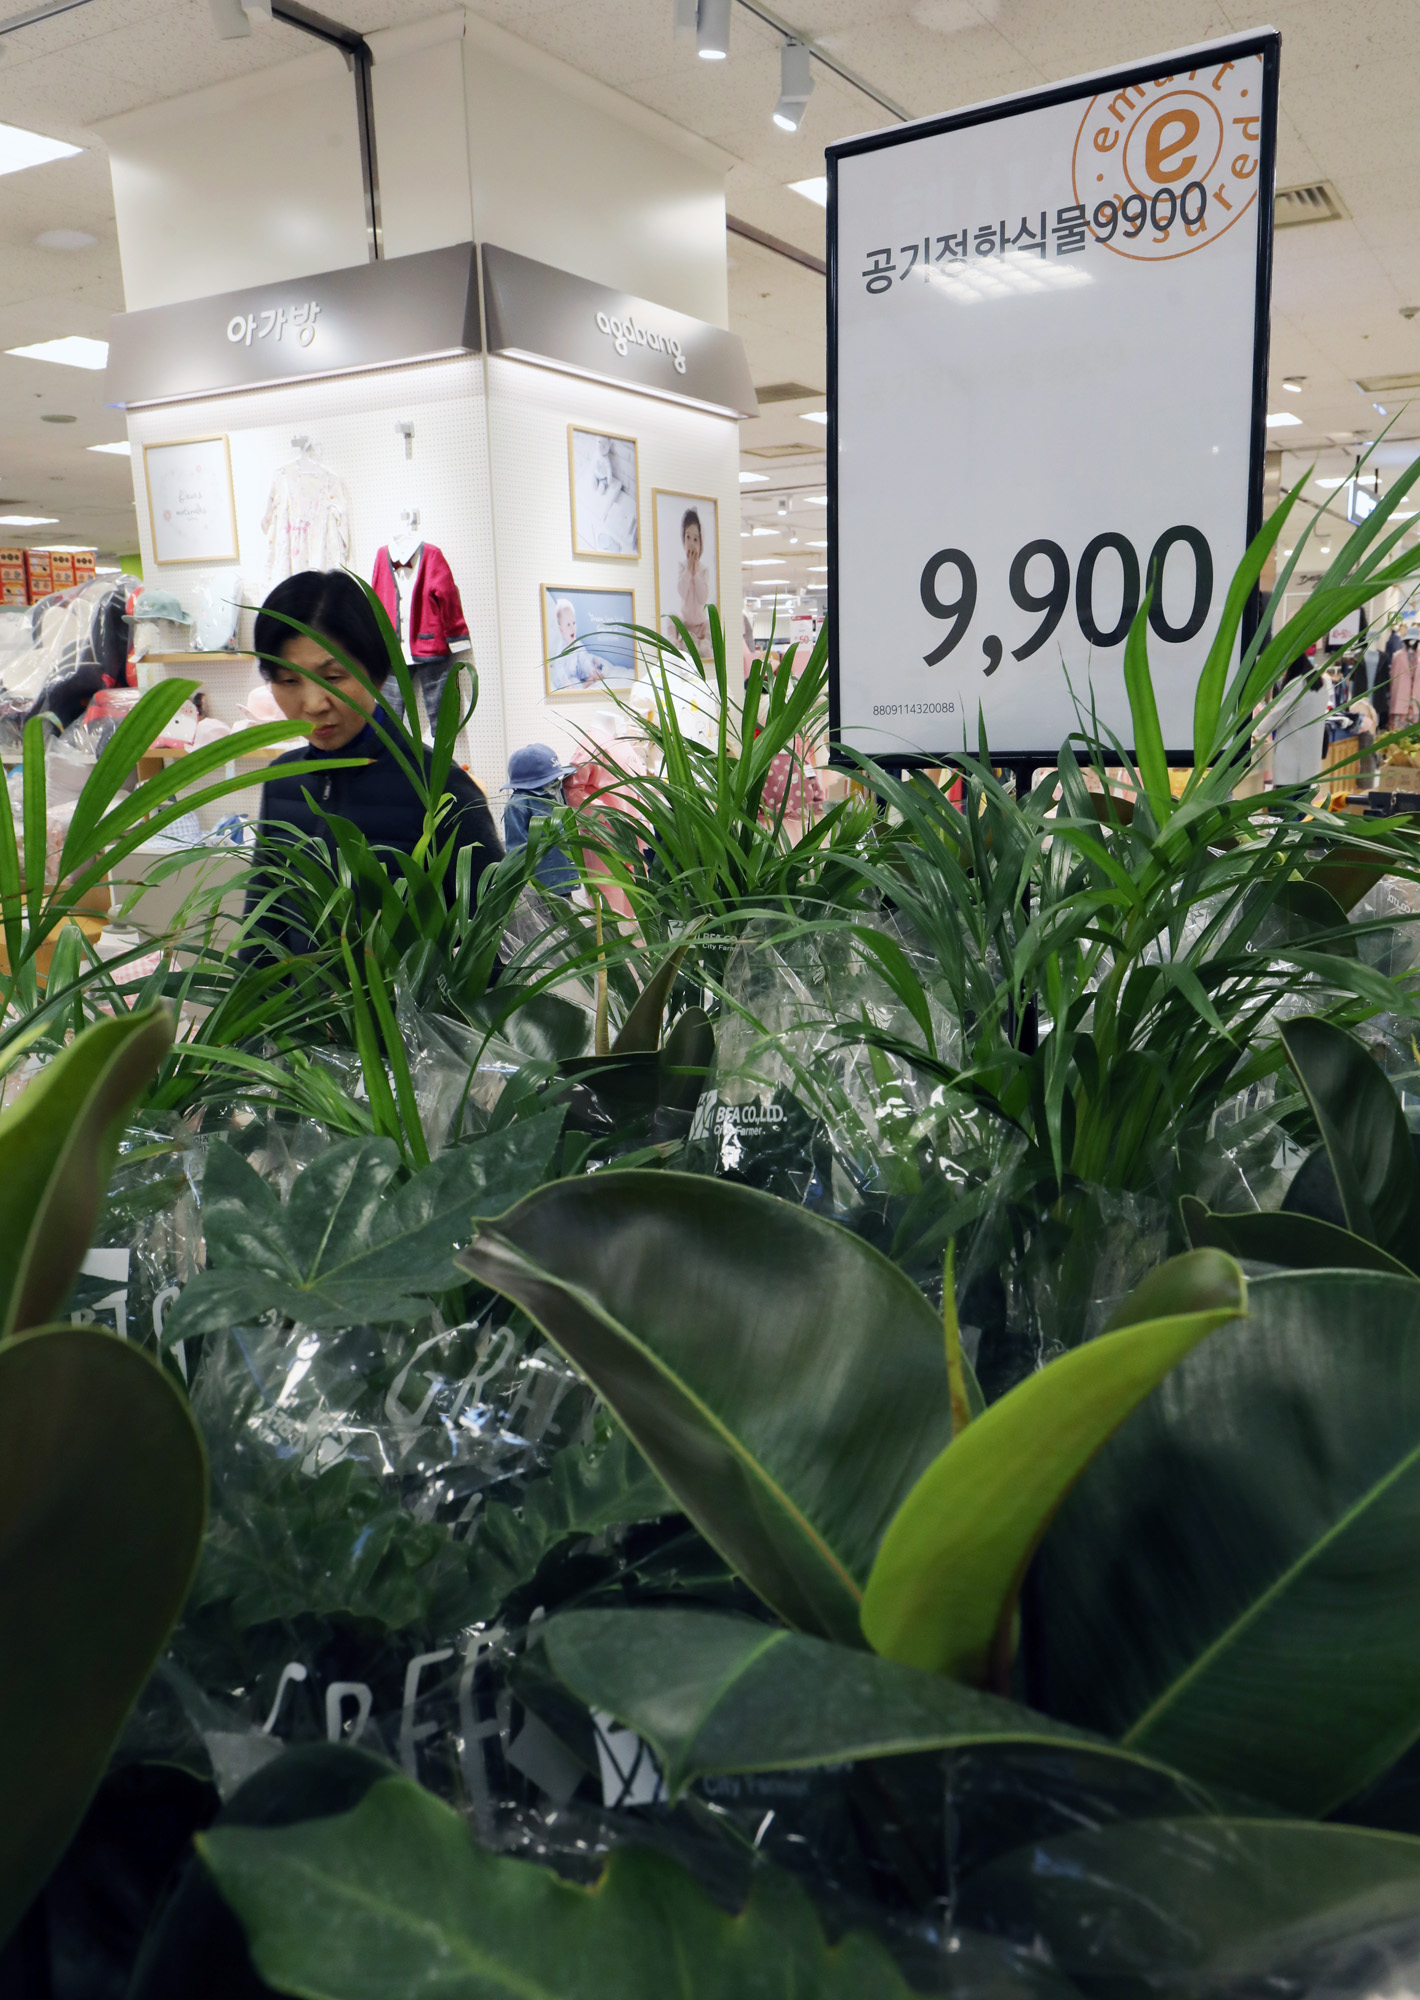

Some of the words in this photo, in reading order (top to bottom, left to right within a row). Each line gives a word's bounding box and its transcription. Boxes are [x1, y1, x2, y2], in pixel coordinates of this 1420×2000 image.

[226, 300, 323, 348] 아가방
[594, 310, 688, 376] agabang
[919, 525, 1214, 677] 9,900
[872, 702, 956, 716] 8809114320088
